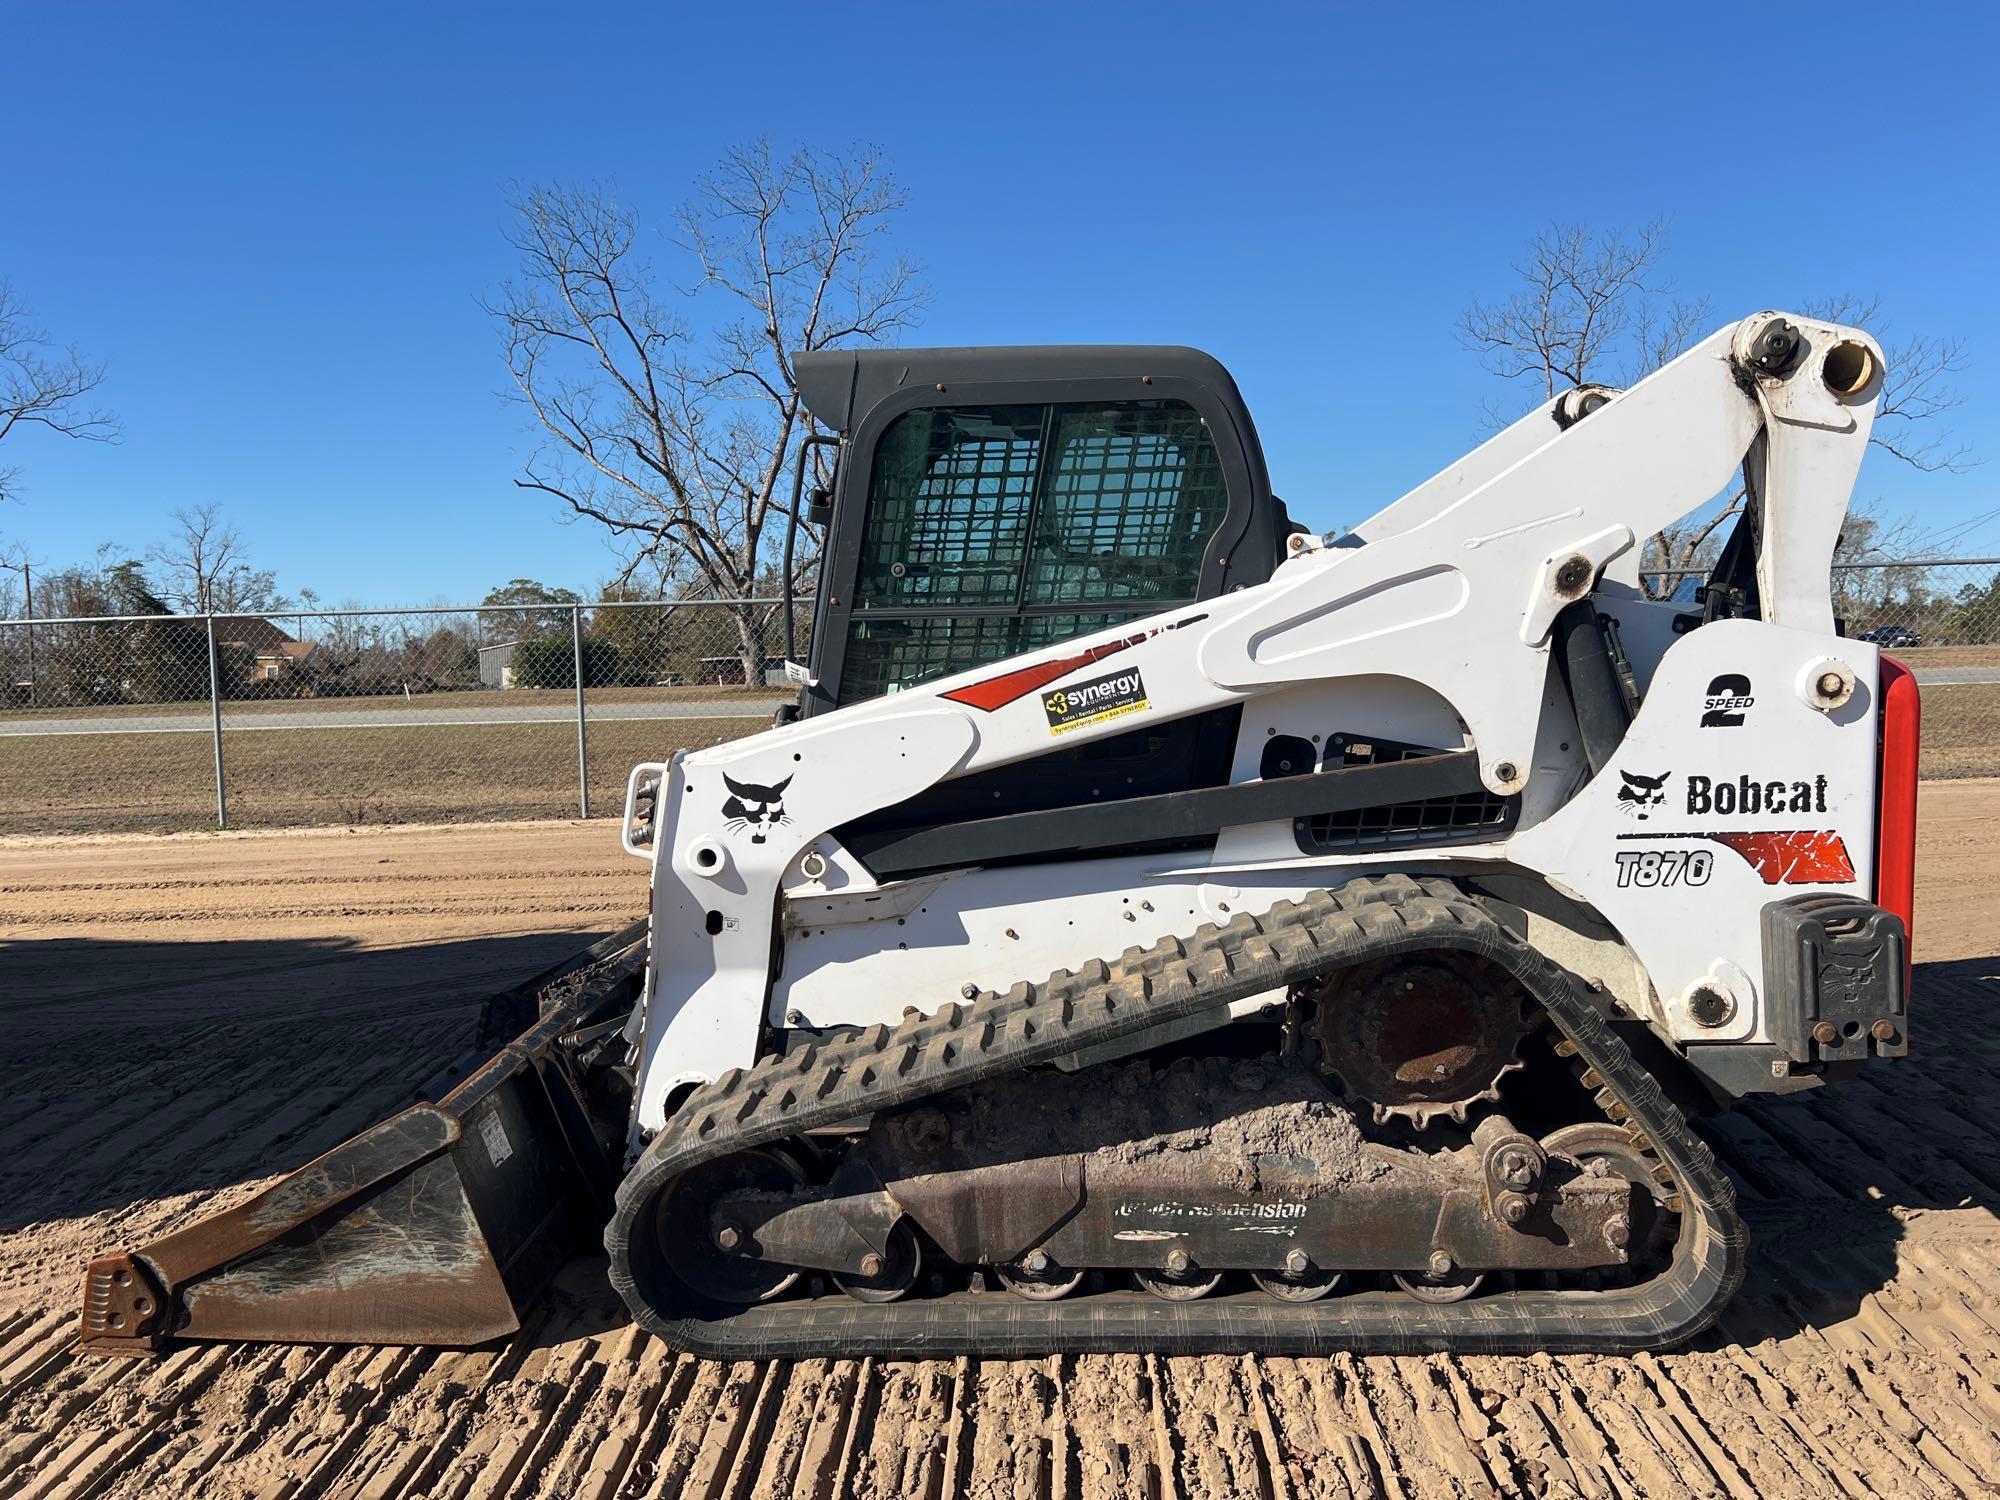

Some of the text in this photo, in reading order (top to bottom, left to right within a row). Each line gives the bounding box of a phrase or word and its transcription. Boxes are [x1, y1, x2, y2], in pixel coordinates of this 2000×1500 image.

[1067, 673, 1139, 707] synergy
[1087, 692, 1121, 706] EQUIPMENT
[1700, 673, 1752, 728] 2
[1704, 697, 1755, 710] SPEED
[1061, 697, 1134, 723] Sales Rental Parts Service
[1687, 775, 1828, 815] Bobcat
[1616, 850, 1713, 888] T870
